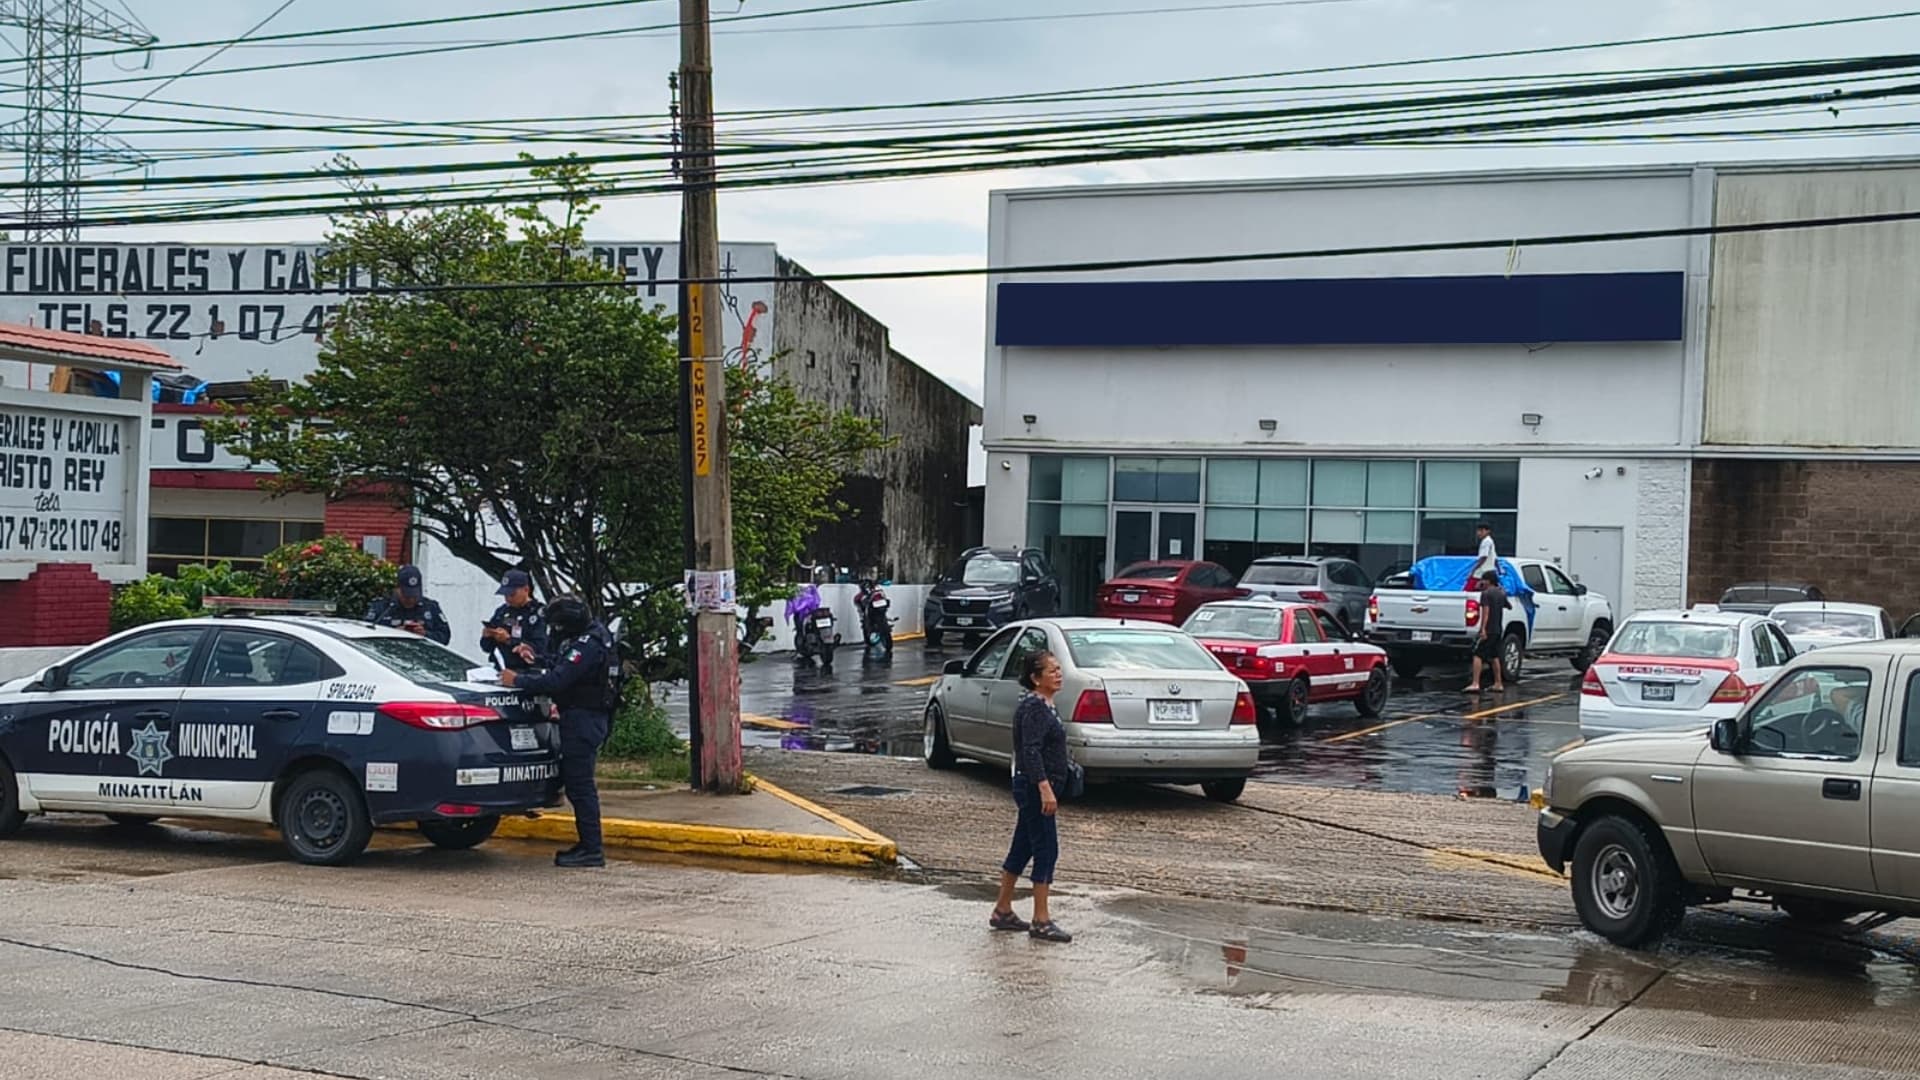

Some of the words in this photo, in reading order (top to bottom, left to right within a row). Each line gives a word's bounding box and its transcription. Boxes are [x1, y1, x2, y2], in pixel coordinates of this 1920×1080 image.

[6, 247, 210, 292] FUNERALES
[228, 248, 247, 291] Y
[146, 304, 191, 340] 22
[208, 304, 219, 340] 1
[239, 305, 285, 340] 07
[692, 296, 702, 333] 12
[693, 368, 706, 467] CMP-227
[52, 418, 63, 451] Y
[67, 419, 120, 455] CAPILLA
[64, 458, 105, 493] REY
[484, 693, 519, 707] POLICÍA
[48, 713, 120, 755] POLICÍA
[179, 723, 257, 759] MUNICIPAL
[98, 782, 203, 801] MINATITLÁN
